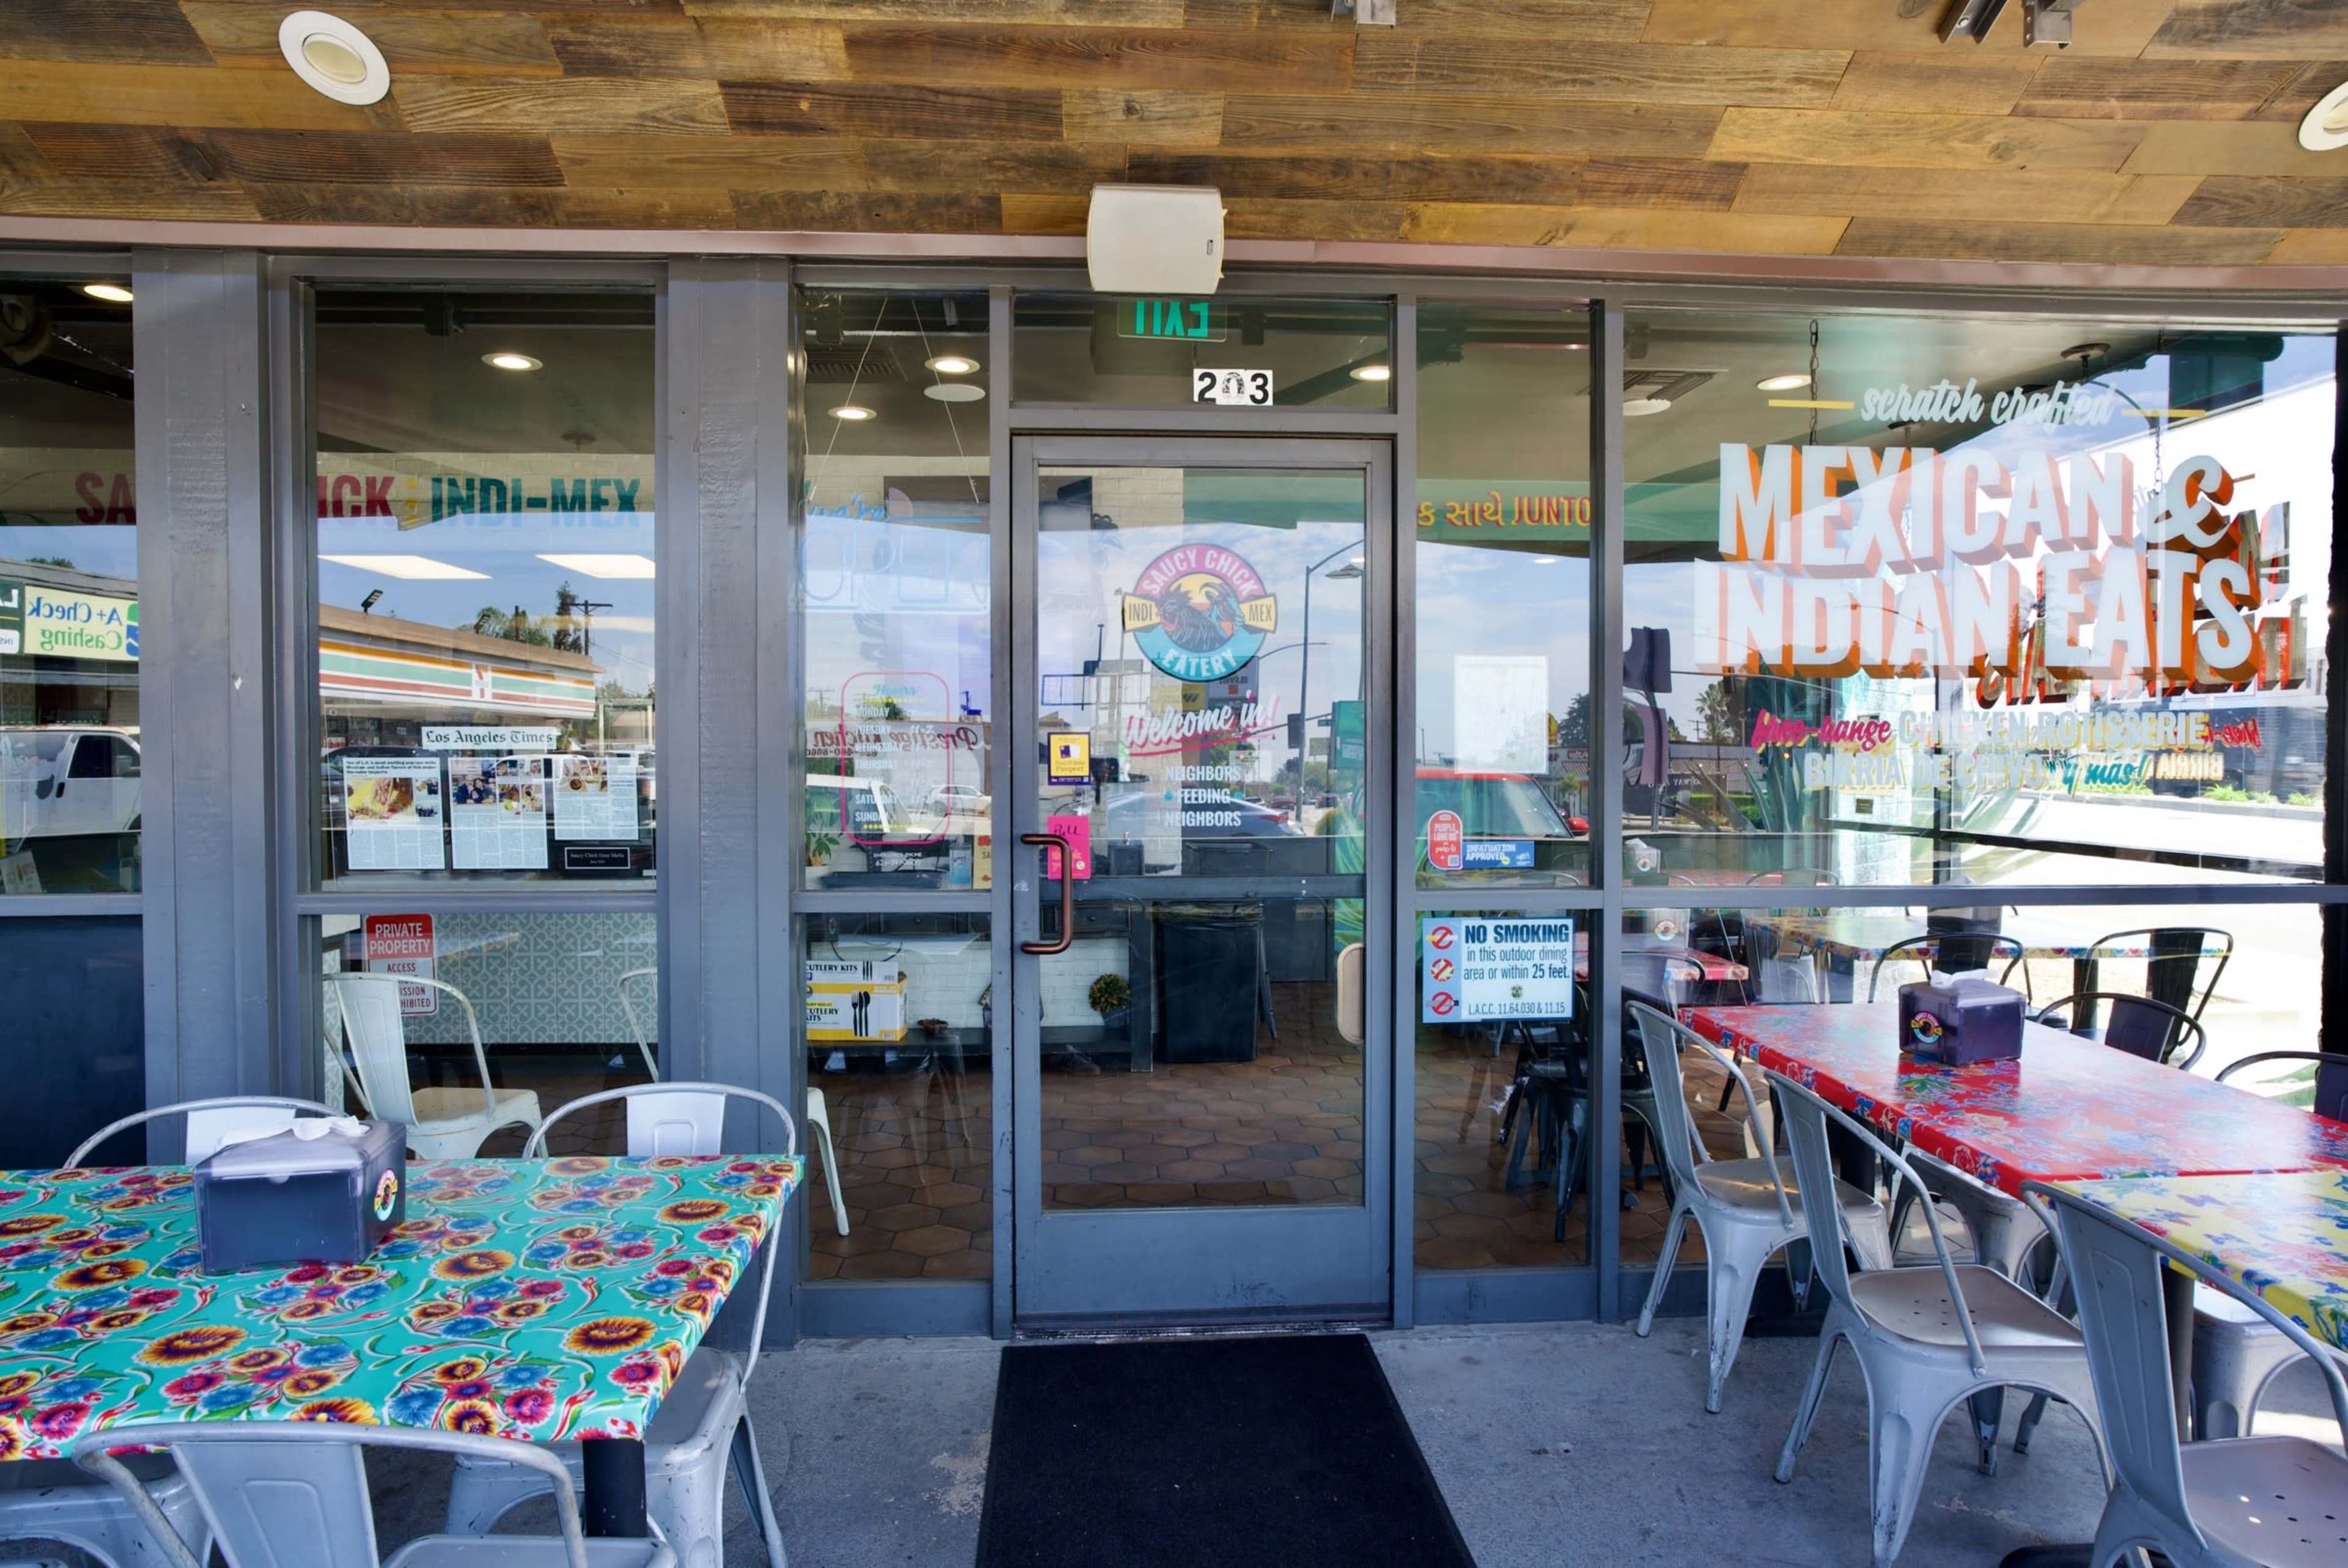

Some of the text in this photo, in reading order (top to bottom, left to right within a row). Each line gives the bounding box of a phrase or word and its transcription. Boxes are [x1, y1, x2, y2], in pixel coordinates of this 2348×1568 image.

[1198, 372, 1269, 405] 203
[1861, 377, 2117, 433] scratch crafted
[75, 472, 136, 525] SA
[317, 473, 640, 528] ICK INDI-MEX
[1444, 491, 1505, 528] સાથે
[1719, 443, 2233, 573] MEXICAN &
[1142, 548, 1259, 596] SAUCY CHICK
[1128, 603, 1153, 622] INDI
[1249, 603, 1272, 622] MEX
[1694, 558, 2015, 676] INDIAN
[2041, 545, 2258, 680] EATS
[1163, 648, 1237, 677] EATERY
[1121, 690, 1281, 748] Welcome in!
[1900, 710, 2029, 746] CHICKEN
[426, 730, 553, 745] Los Angeles Times
[855, 724, 891, 735] TUESDAY
[1165, 765, 1241, 781] NEIGHBORS
[1804, 753, 1904, 789] BIRRIA
[1914, 754, 1952, 789] DE
[2084, 753, 2152, 787] más!
[855, 794, 897, 804] SATUDAY
[1177, 788, 1231, 804] FEEDING
[1165, 811, 1242, 826] NEIGHBORS
[1466, 852, 1505, 861] APPROVED
[375, 923, 423, 938] PRIVATE
[1465, 924, 1570, 944] NO SMOKING
[370, 939, 430, 954] PROPERTY
[1468, 947, 1567, 964] in this outdoor dining
[386, 963, 416, 973] ACCESS
[1464, 963, 1570, 980] area or within 25 feet.
[400, 987, 426, 996] ISSION
[401, 998, 430, 1008] HIBITED
[1468, 1002, 1565, 1015] L.A.C.C. 11.64.030 & 11.15
